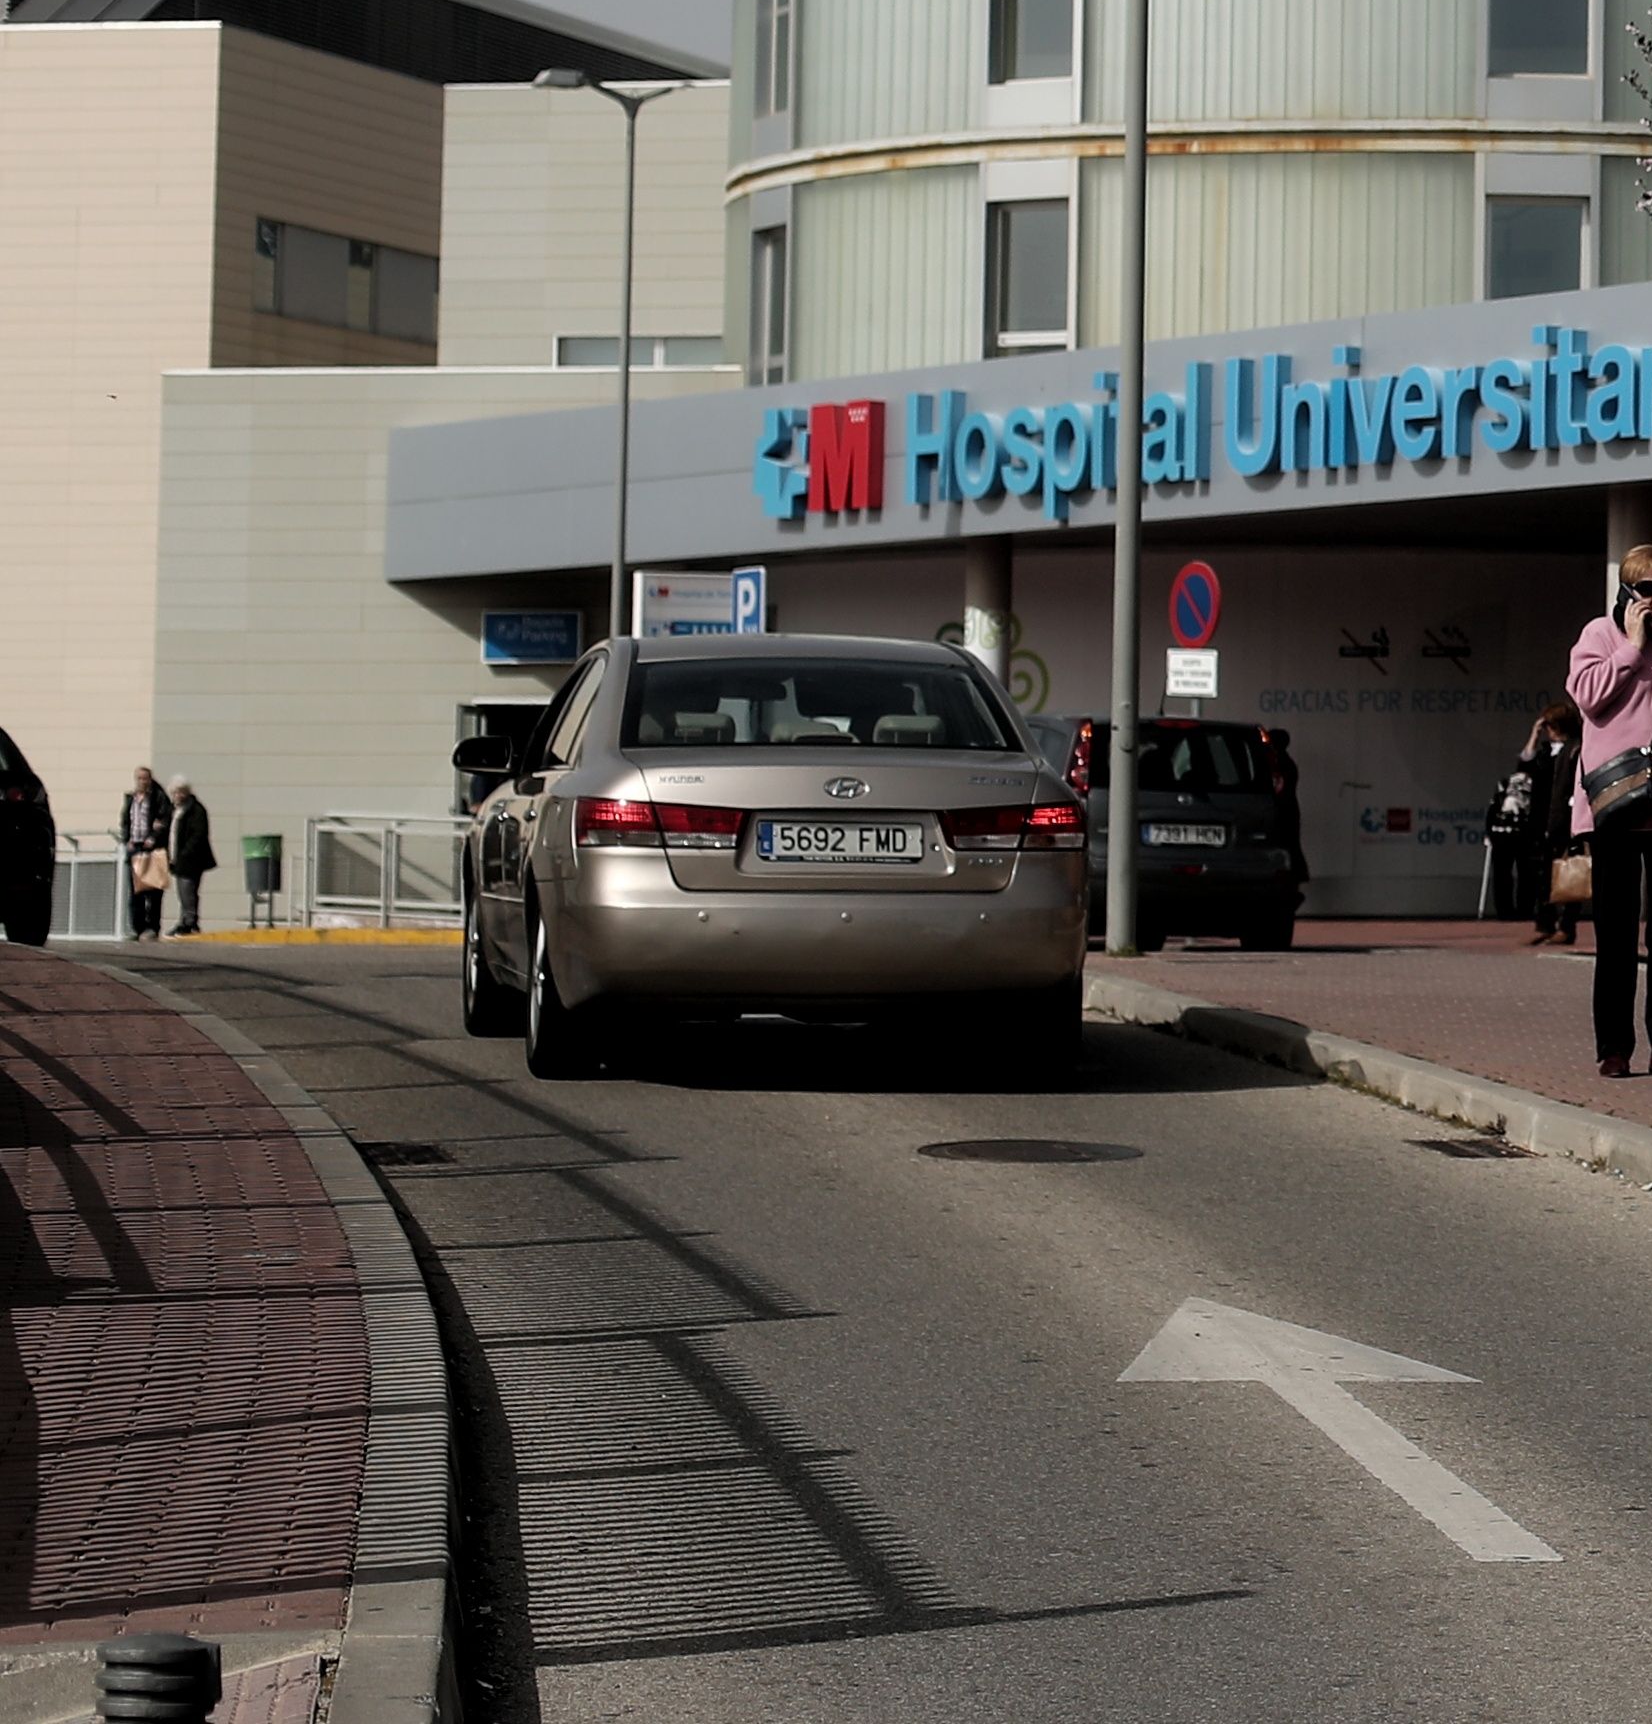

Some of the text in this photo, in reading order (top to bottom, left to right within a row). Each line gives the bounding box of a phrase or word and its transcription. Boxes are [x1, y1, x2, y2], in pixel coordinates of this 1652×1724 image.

[905, 360, 1213, 521] Hospial
[1259, 689, 1551, 714] GRACIAS POR RESPETARLO
[1417, 807, 1486, 822] Hospital
[780, 826, 907, 853] 5692 FMD
[1416, 825, 1446, 845] de
